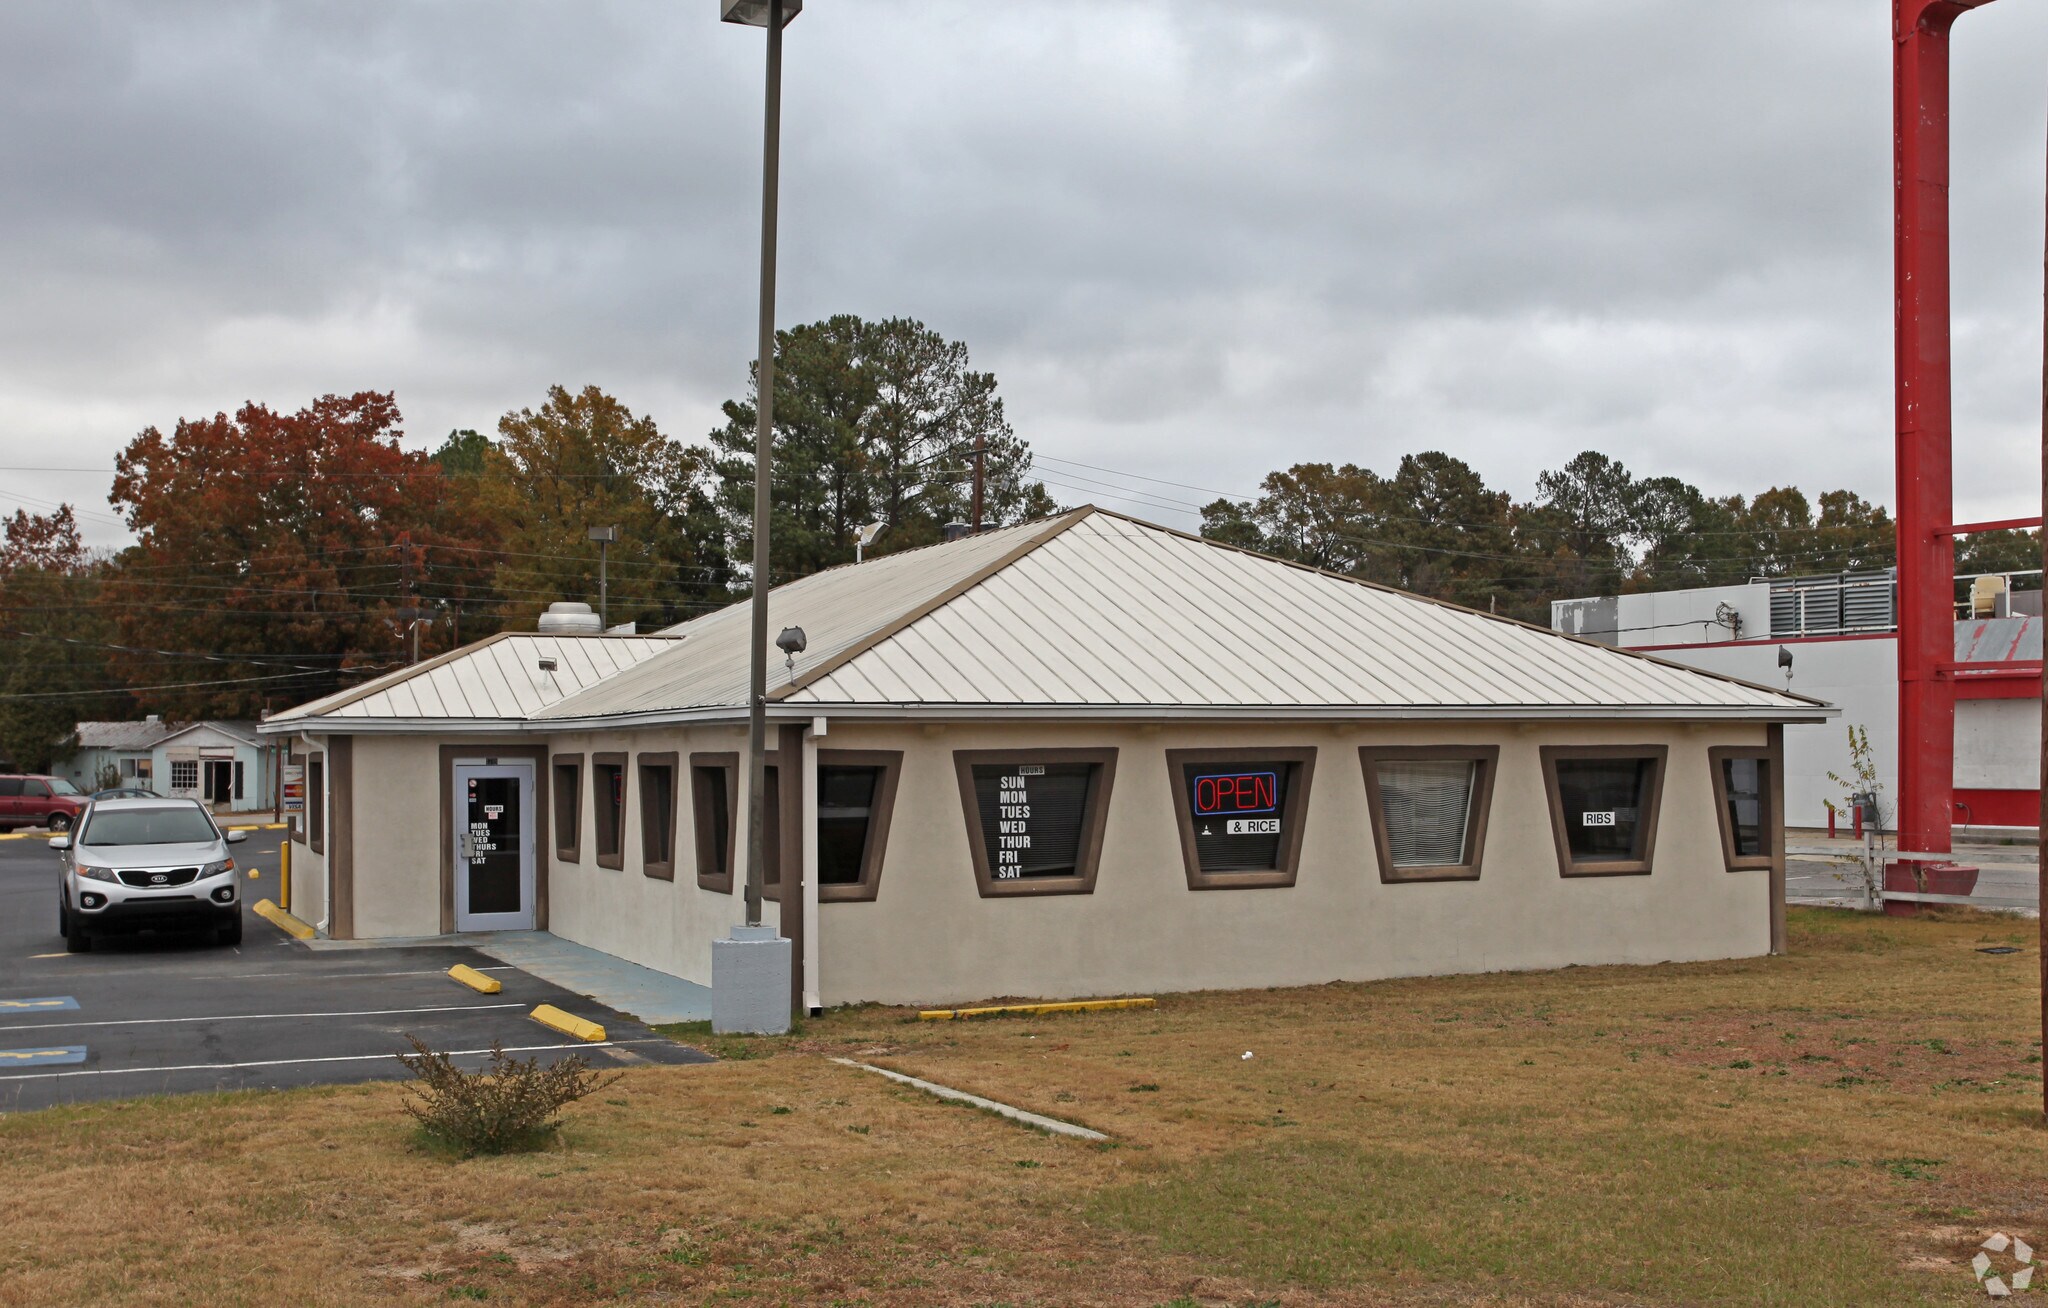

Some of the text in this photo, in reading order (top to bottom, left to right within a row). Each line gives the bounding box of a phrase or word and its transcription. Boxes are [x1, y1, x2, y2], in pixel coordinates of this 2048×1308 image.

[1020, 766, 1044, 774] HOURS
[1000, 776, 1025, 789] SUN
[1000, 790, 1027, 804] MON
[1197, 776, 1273, 811] OPEN
[1000, 805, 1031, 819] TUES
[1586, 813, 1611, 824] RIBS
[999, 820, 1026, 834] WED
[1233, 820, 1276, 833] & RICE
[999, 835, 1031, 849] THUR
[999, 850, 1018, 864] FRI
[999, 865, 1022, 879] SAT
